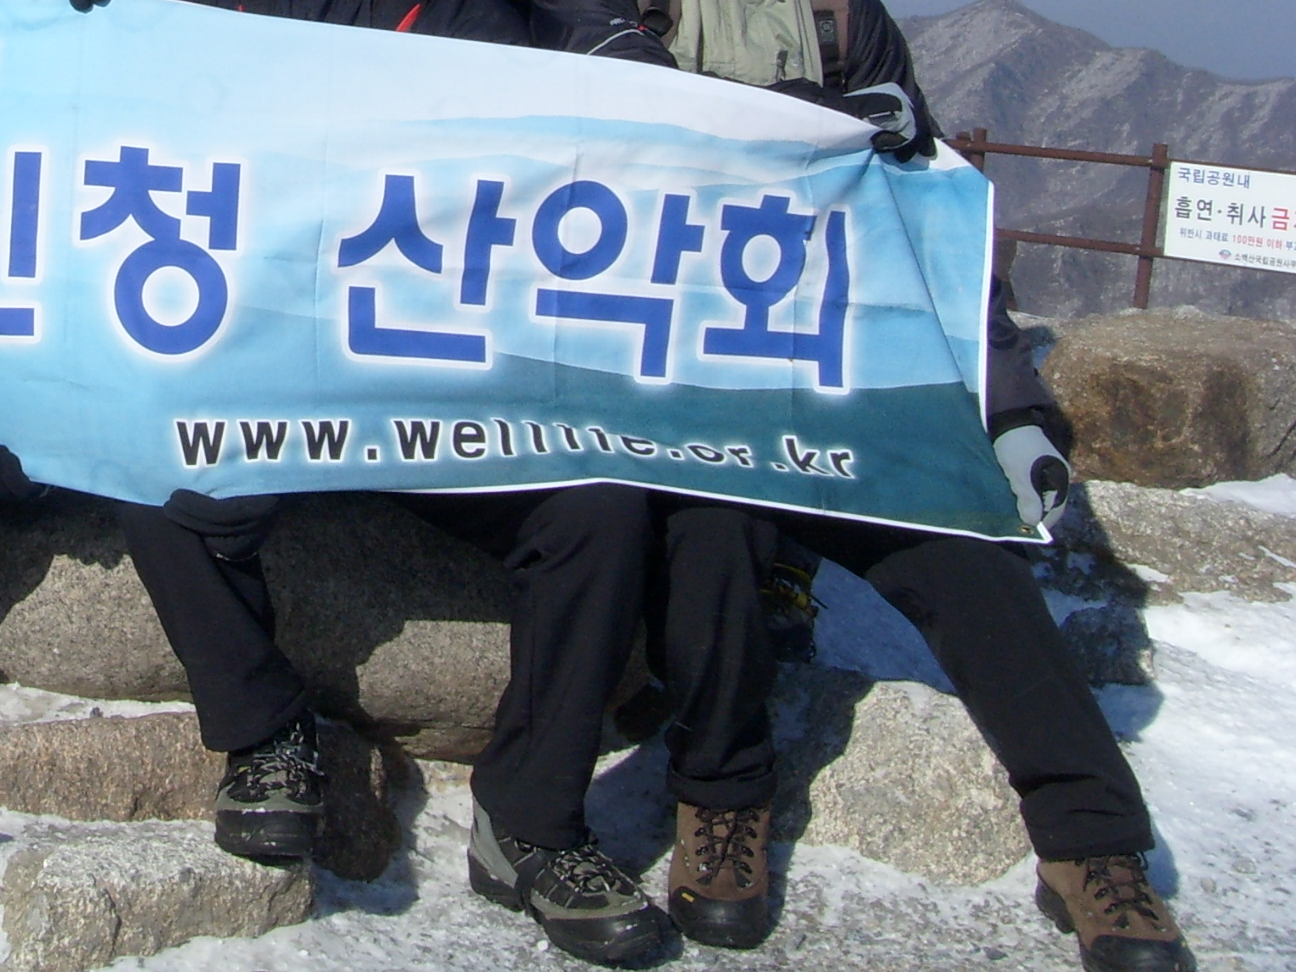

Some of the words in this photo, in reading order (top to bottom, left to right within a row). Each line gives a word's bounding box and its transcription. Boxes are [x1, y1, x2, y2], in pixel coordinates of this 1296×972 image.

[1178, 167, 1251, 189] 국립공원내
[1271, 207, 1296, 231] 금
[1179, 227, 1202, 239] 위반시
[1205, 231, 1229, 242] 과태료
[1232, 234, 1264, 248] 100만원
[1266, 238, 1283, 250] 이하
[338, 174, 848, 387] 산악회
